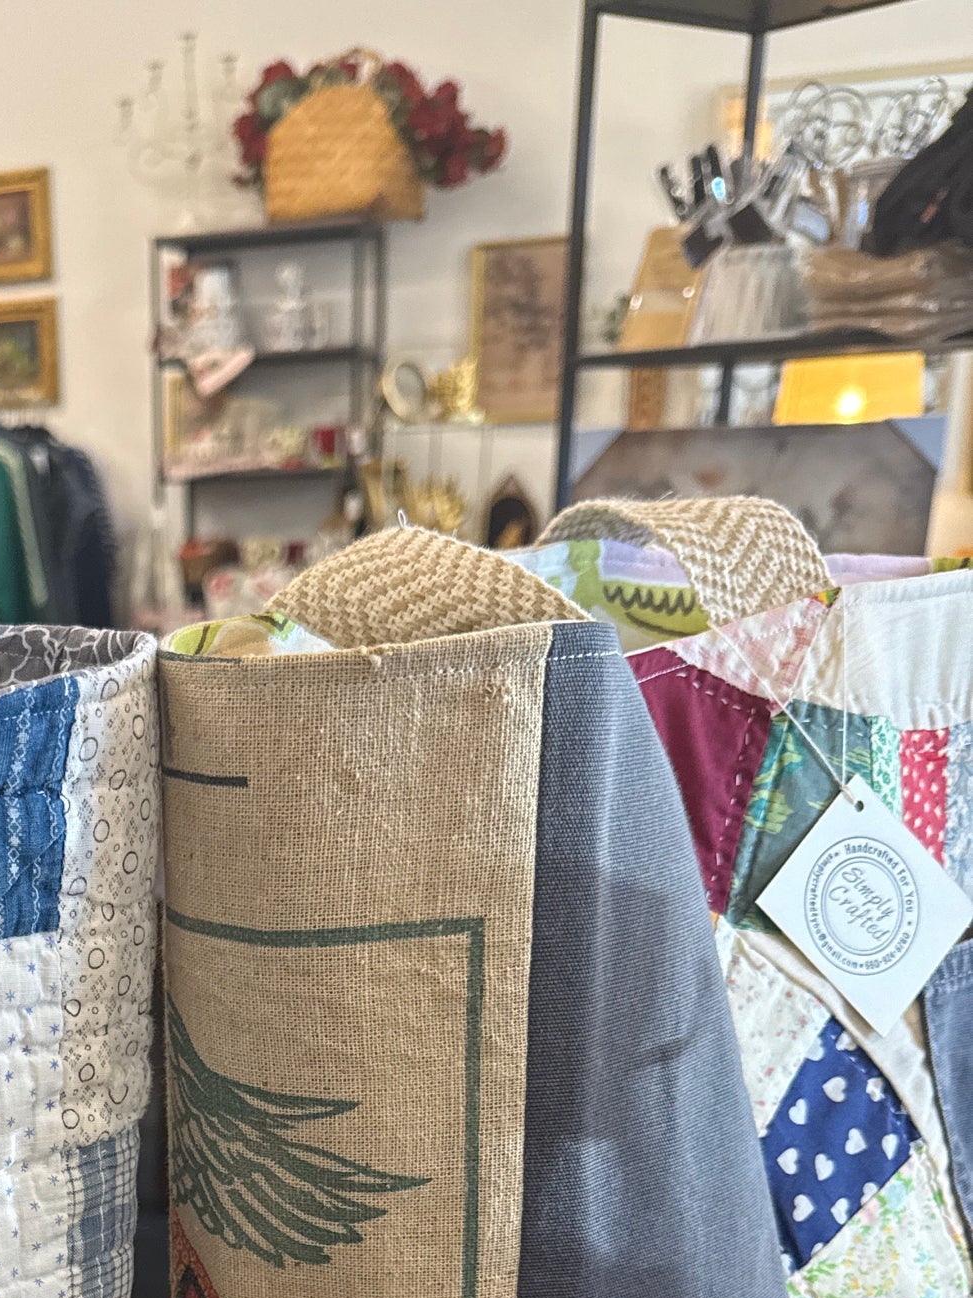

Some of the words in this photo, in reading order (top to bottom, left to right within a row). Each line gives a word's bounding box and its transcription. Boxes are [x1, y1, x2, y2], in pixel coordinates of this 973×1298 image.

[841, 867, 896, 923] Simply
[844, 841, 898, 870] Handcrafted
[895, 868, 910, 887] For
[903, 890, 916, 913] You
[828, 885, 889, 942] Crafted
